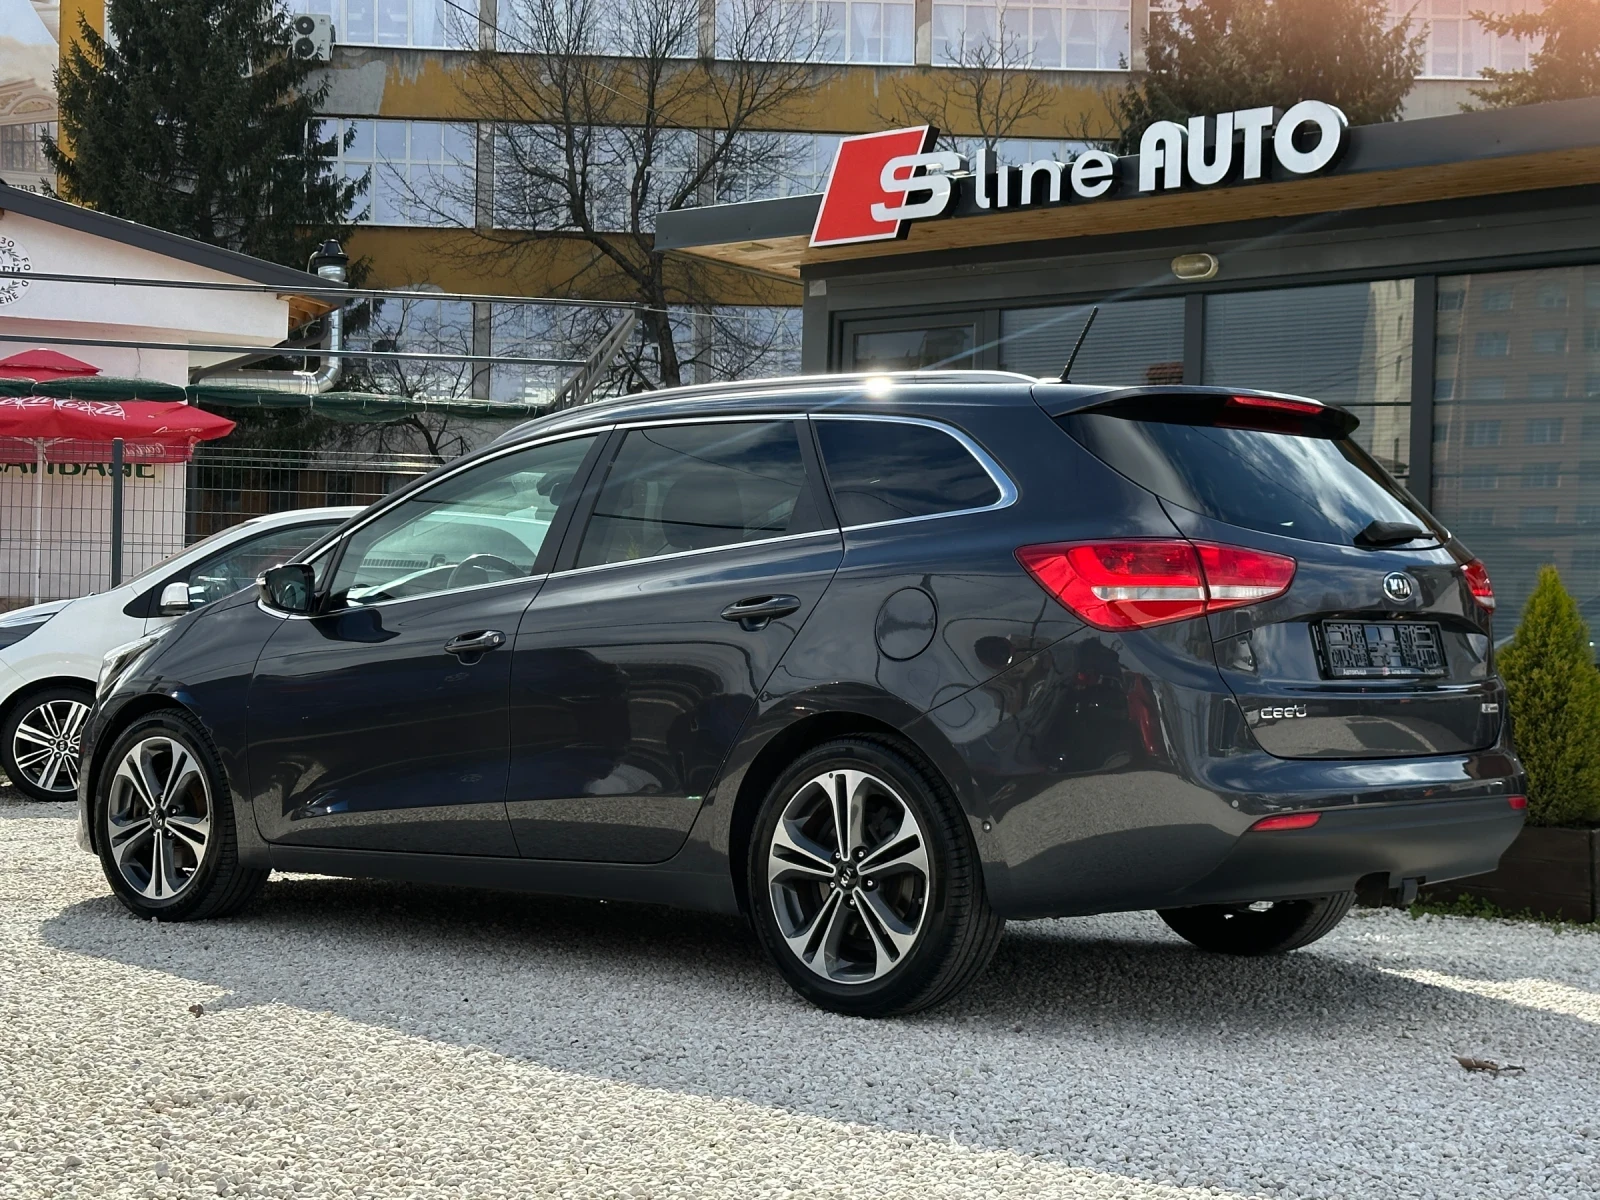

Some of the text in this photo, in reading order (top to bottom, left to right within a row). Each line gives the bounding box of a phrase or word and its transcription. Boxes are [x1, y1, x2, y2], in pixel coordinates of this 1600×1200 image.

[871, 100, 1344, 223] S line AUTO
[21, 257, 31, 287] FOD
[1388, 578, 1411, 595] KIA
